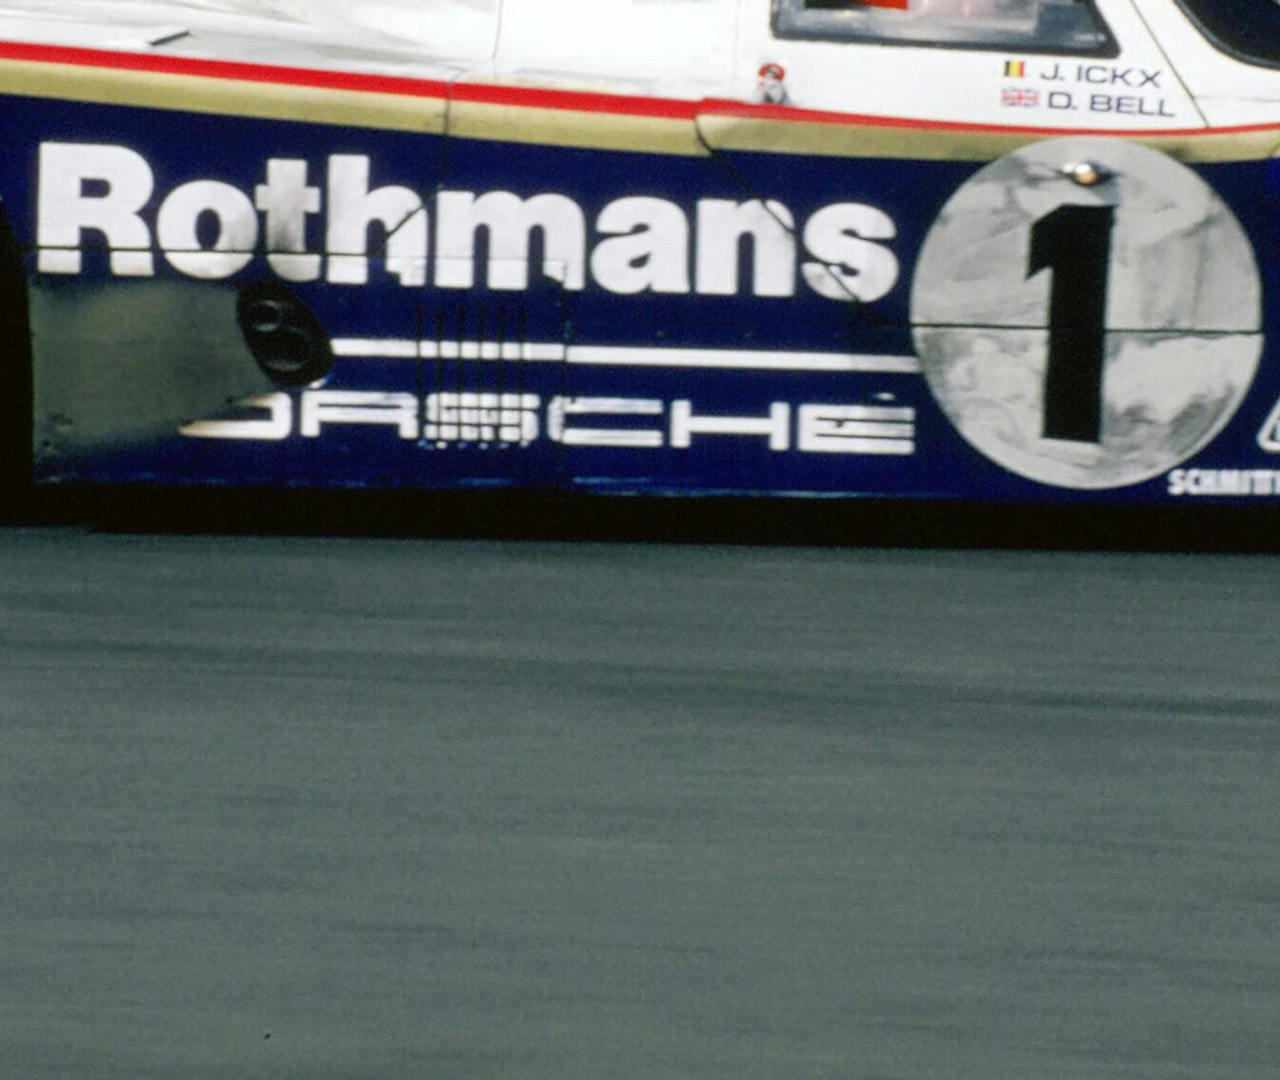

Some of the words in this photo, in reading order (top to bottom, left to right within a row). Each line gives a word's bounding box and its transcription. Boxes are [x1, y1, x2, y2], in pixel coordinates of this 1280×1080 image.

[1040, 63, 1065, 81] J.
[1077, 65, 1161, 88] ICKX
[1048, 91, 1078, 110] D.
[1090, 94, 1176, 117] BELL
[36, 142, 899, 301] Rothmans
[1025, 204, 1115, 444] 1
[180, 389, 915, 455] ORSCHE
